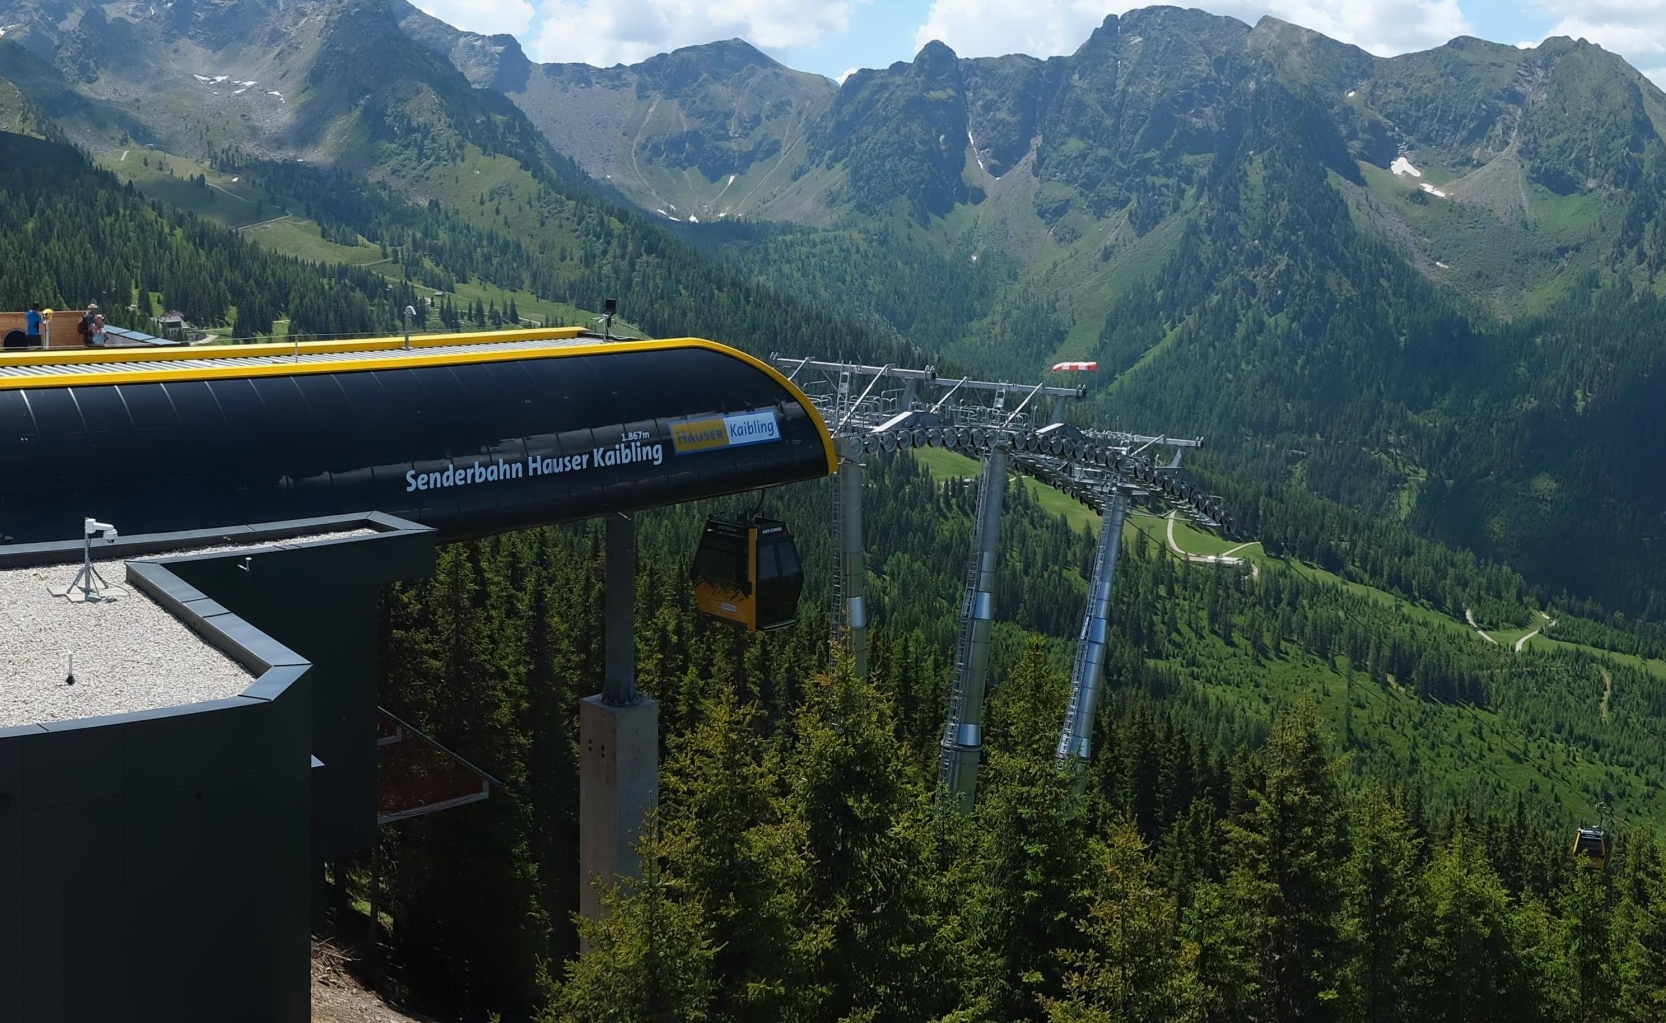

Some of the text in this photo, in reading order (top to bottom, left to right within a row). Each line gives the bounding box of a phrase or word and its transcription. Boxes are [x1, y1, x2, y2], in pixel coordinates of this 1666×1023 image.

[621, 430, 650, 442] 1.867m
[730, 420, 775, 438] Kaibling
[406, 442, 663, 492] Senderbahn Hauser Kaibling
